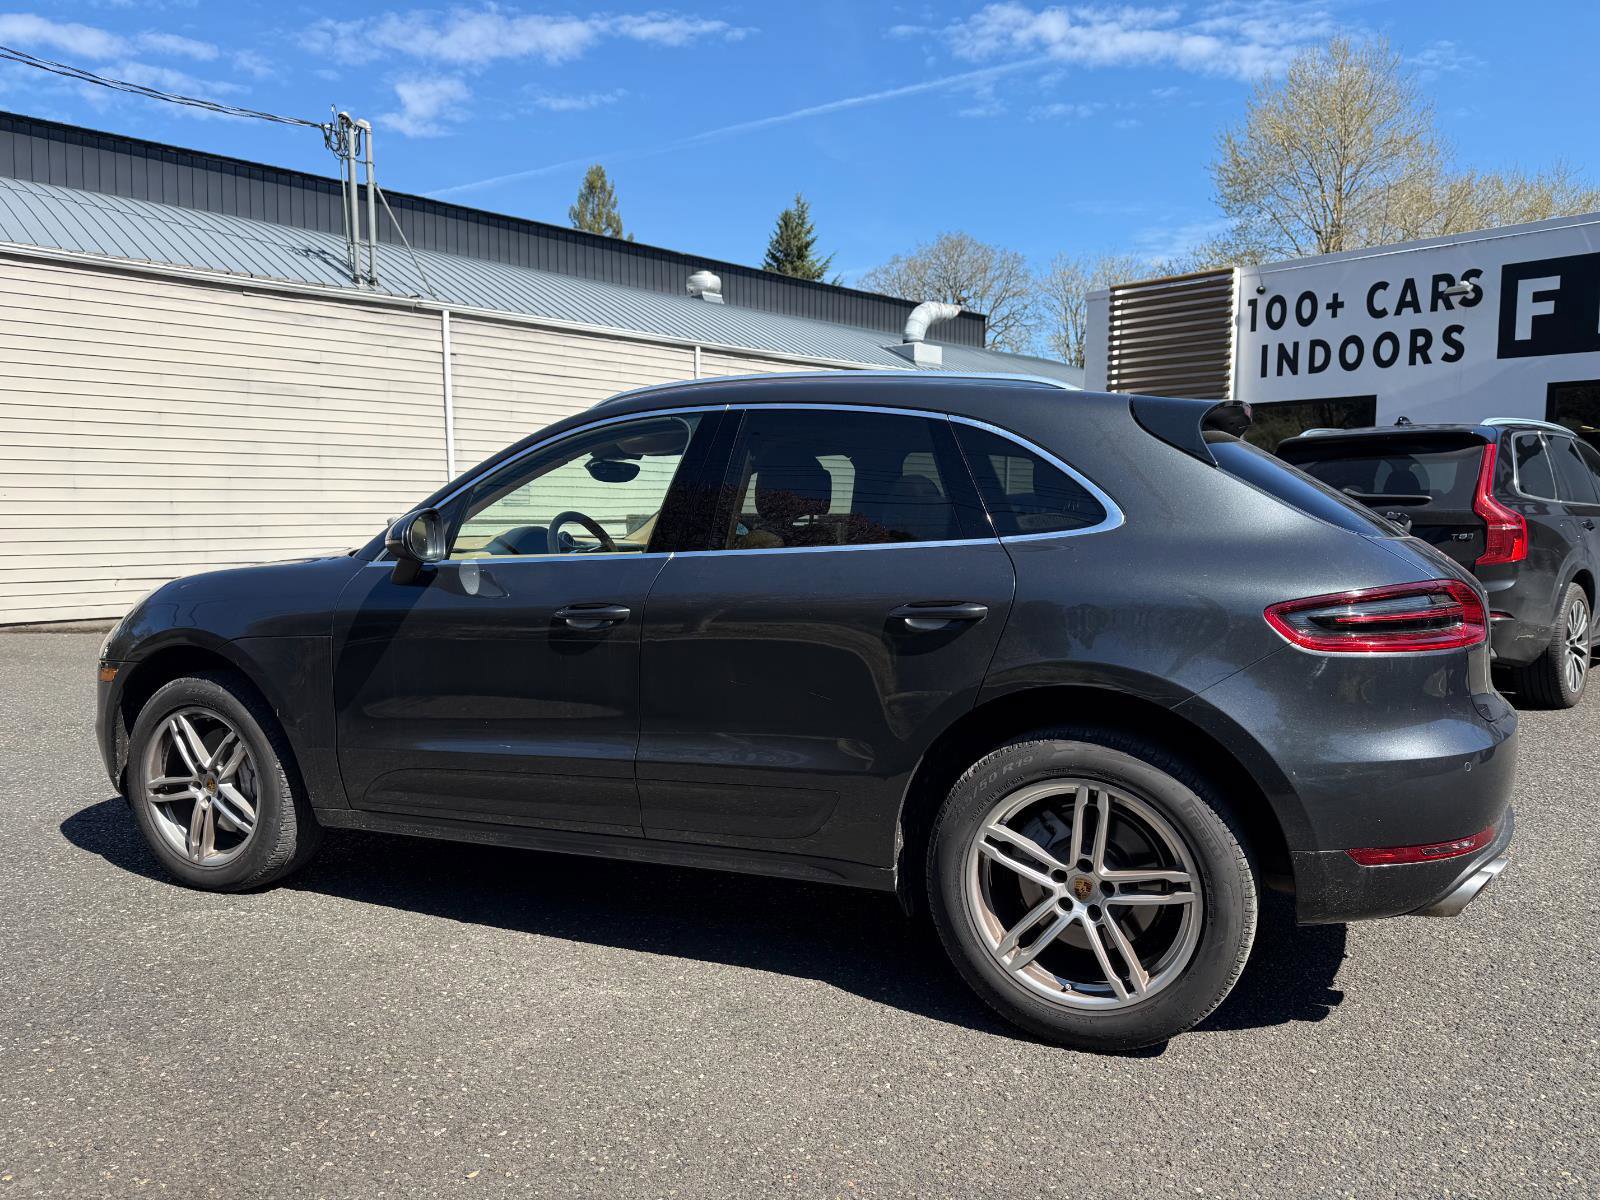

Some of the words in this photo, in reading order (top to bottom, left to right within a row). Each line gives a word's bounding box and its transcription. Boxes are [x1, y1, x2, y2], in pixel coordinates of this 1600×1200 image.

[1247, 290, 1345, 333] 100+
[1366, 268, 1484, 319] CARS
[1260, 324, 1466, 378] INDOORS
